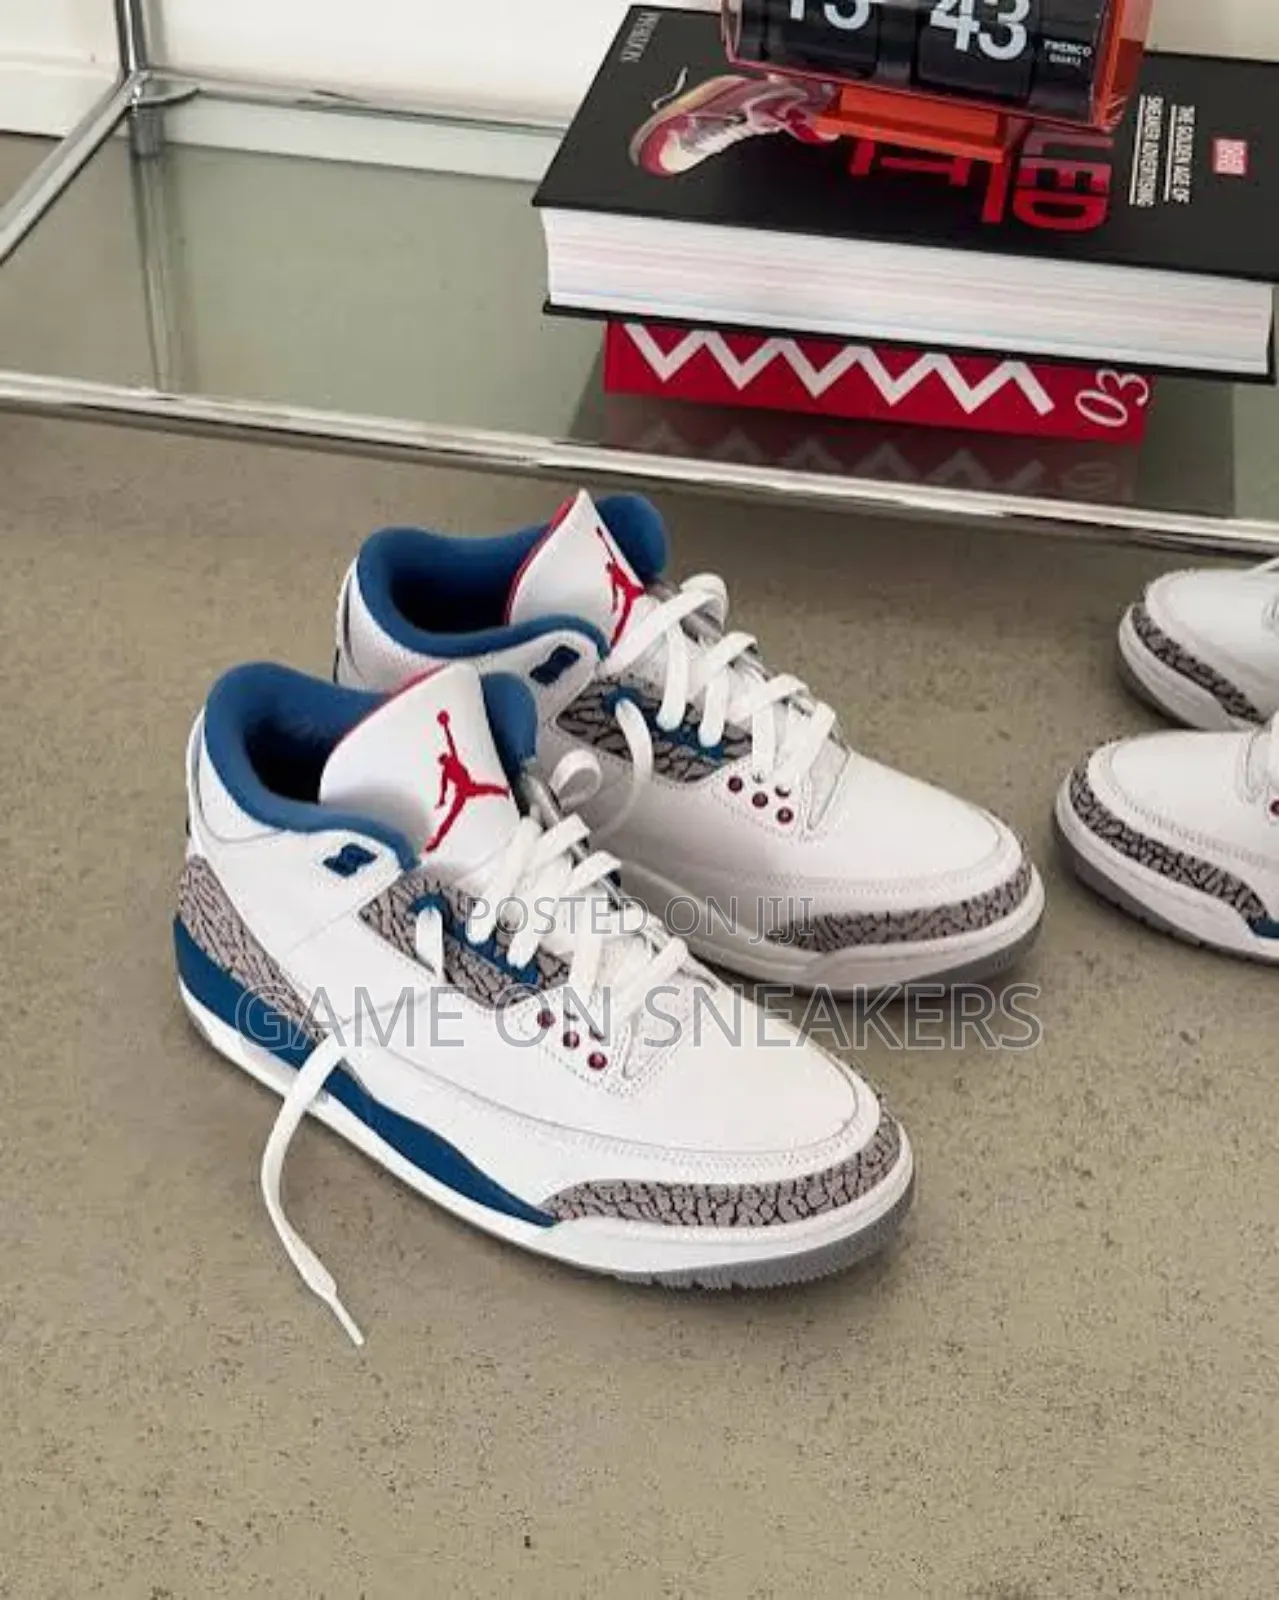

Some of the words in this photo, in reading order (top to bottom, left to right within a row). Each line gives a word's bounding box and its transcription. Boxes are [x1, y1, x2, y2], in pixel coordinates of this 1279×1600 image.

[930, 0, 1029, 60] 43
[1144, 95, 1164, 140] SNEAKER
[1178, 105, 1195, 124] THE
[1174, 125, 1193, 163] GOLDEN
[1137, 141, 1160, 208] ADVERTISING
[1173, 164, 1190, 186] AGE
[1172, 187, 1190, 204] OF
[1075, 368, 1148, 427] 03
